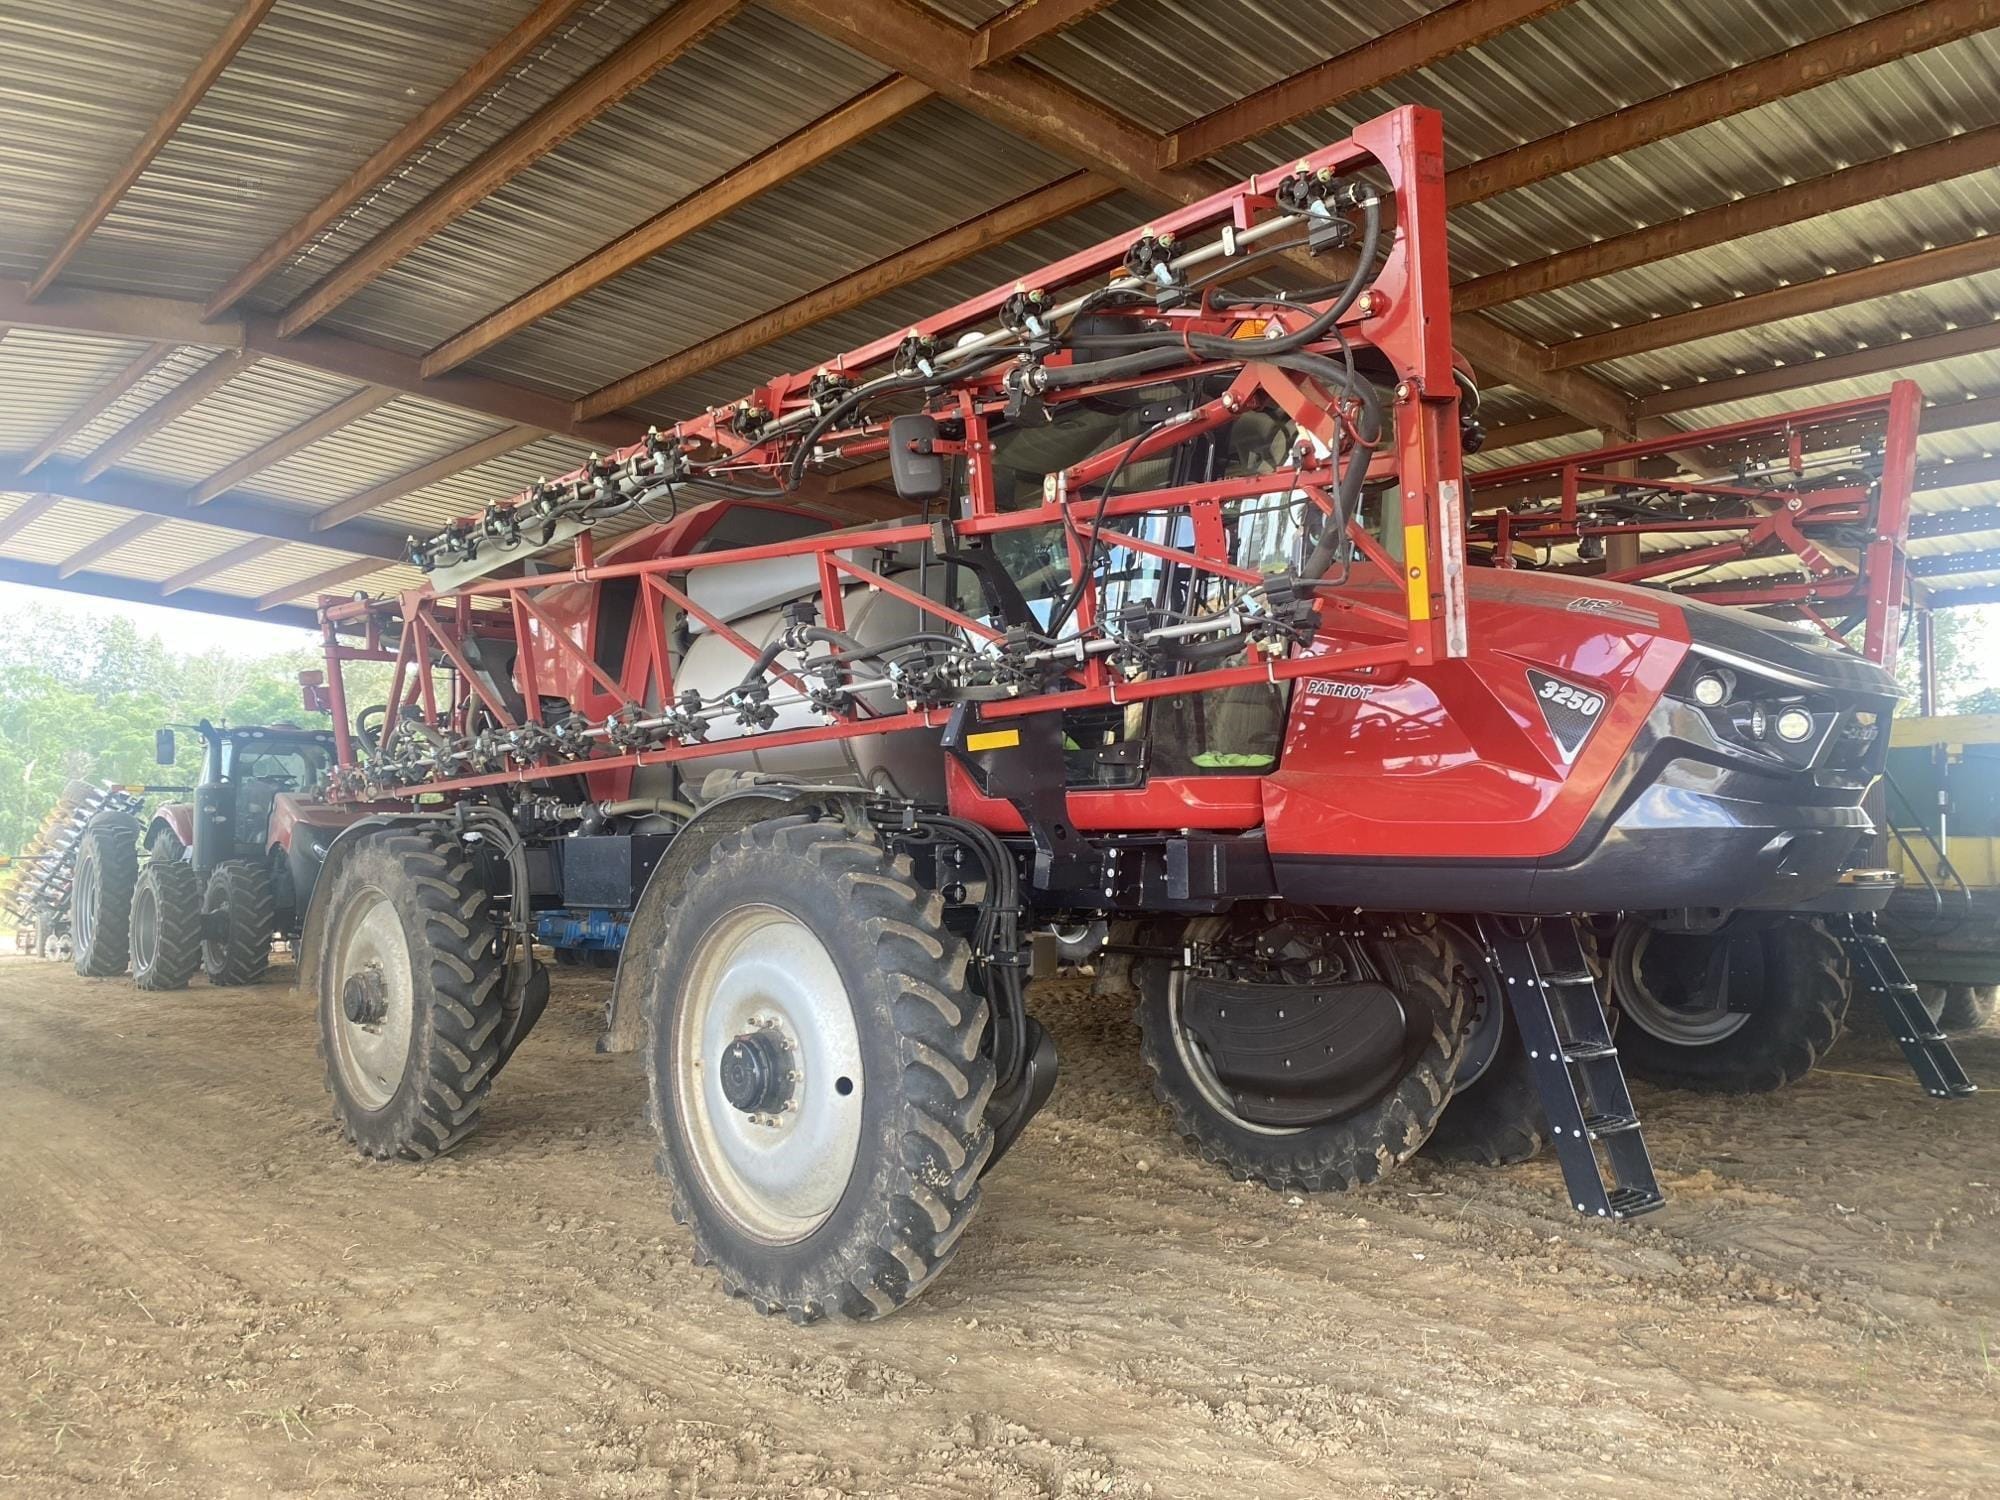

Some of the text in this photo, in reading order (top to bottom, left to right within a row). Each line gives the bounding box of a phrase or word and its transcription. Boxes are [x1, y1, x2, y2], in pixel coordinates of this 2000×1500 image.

[1568, 597, 1611, 610] AFS
[1306, 680, 1372, 699] PATRIOT
[1539, 681, 1601, 716] 3250
